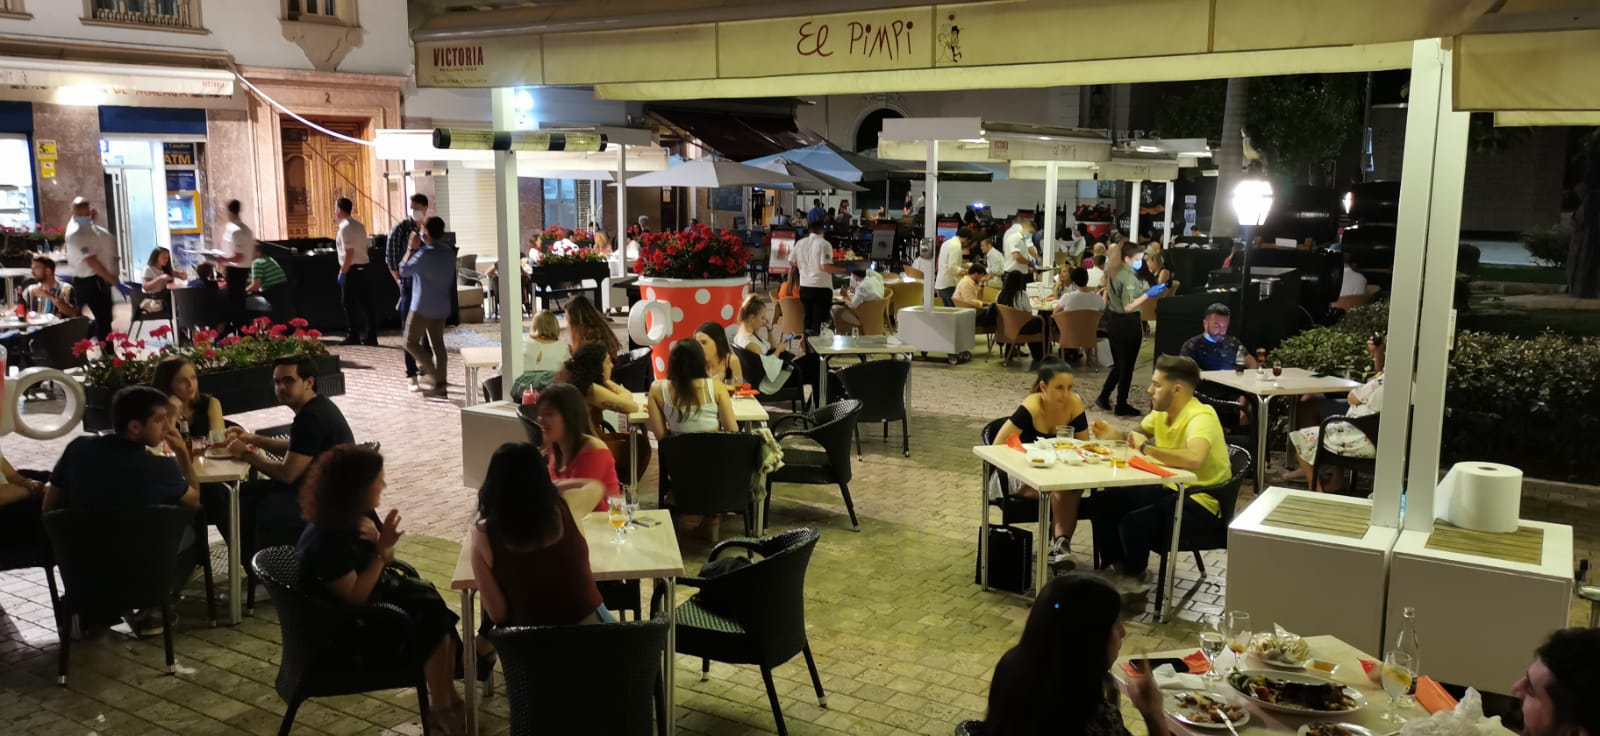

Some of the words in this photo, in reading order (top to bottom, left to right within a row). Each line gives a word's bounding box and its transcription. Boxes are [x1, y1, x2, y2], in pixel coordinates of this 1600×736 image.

[796, 21, 834, 57] El
[433, 46, 484, 67] VICTORIA
[325, 91, 332, 104] 2
[164, 153, 191, 165] ATM
